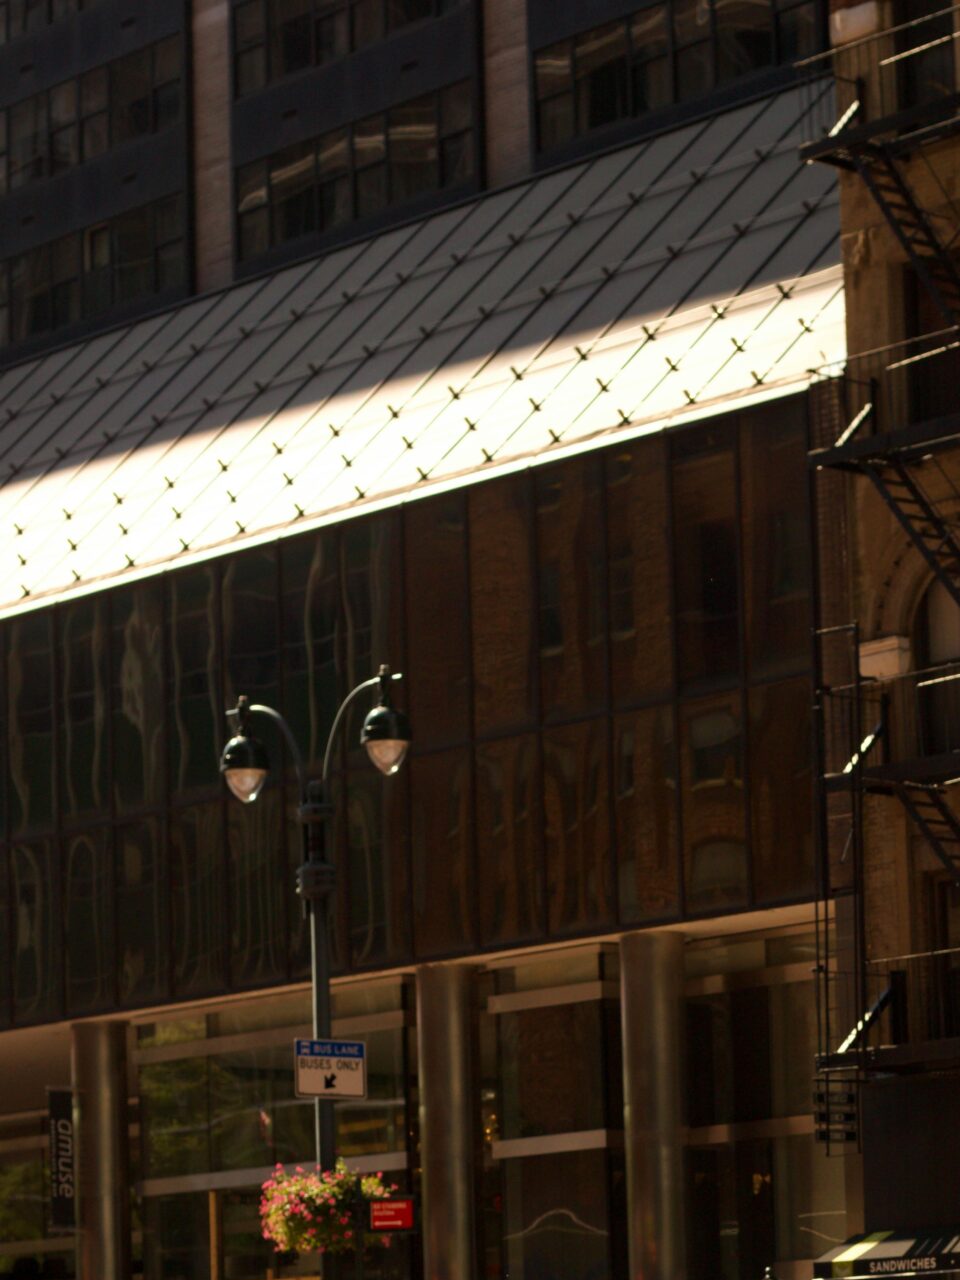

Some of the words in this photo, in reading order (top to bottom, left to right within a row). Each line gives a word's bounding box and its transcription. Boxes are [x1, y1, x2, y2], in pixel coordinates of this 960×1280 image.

[313, 1044, 332, 1054] BUS
[335, 1045, 359, 1055] LANE
[300, 1058, 332, 1070] BUSES
[336, 1060, 359, 1071] ONLY
[57, 1119, 74, 1198] amuse
[869, 1257, 937, 1273] SANDWICHES
